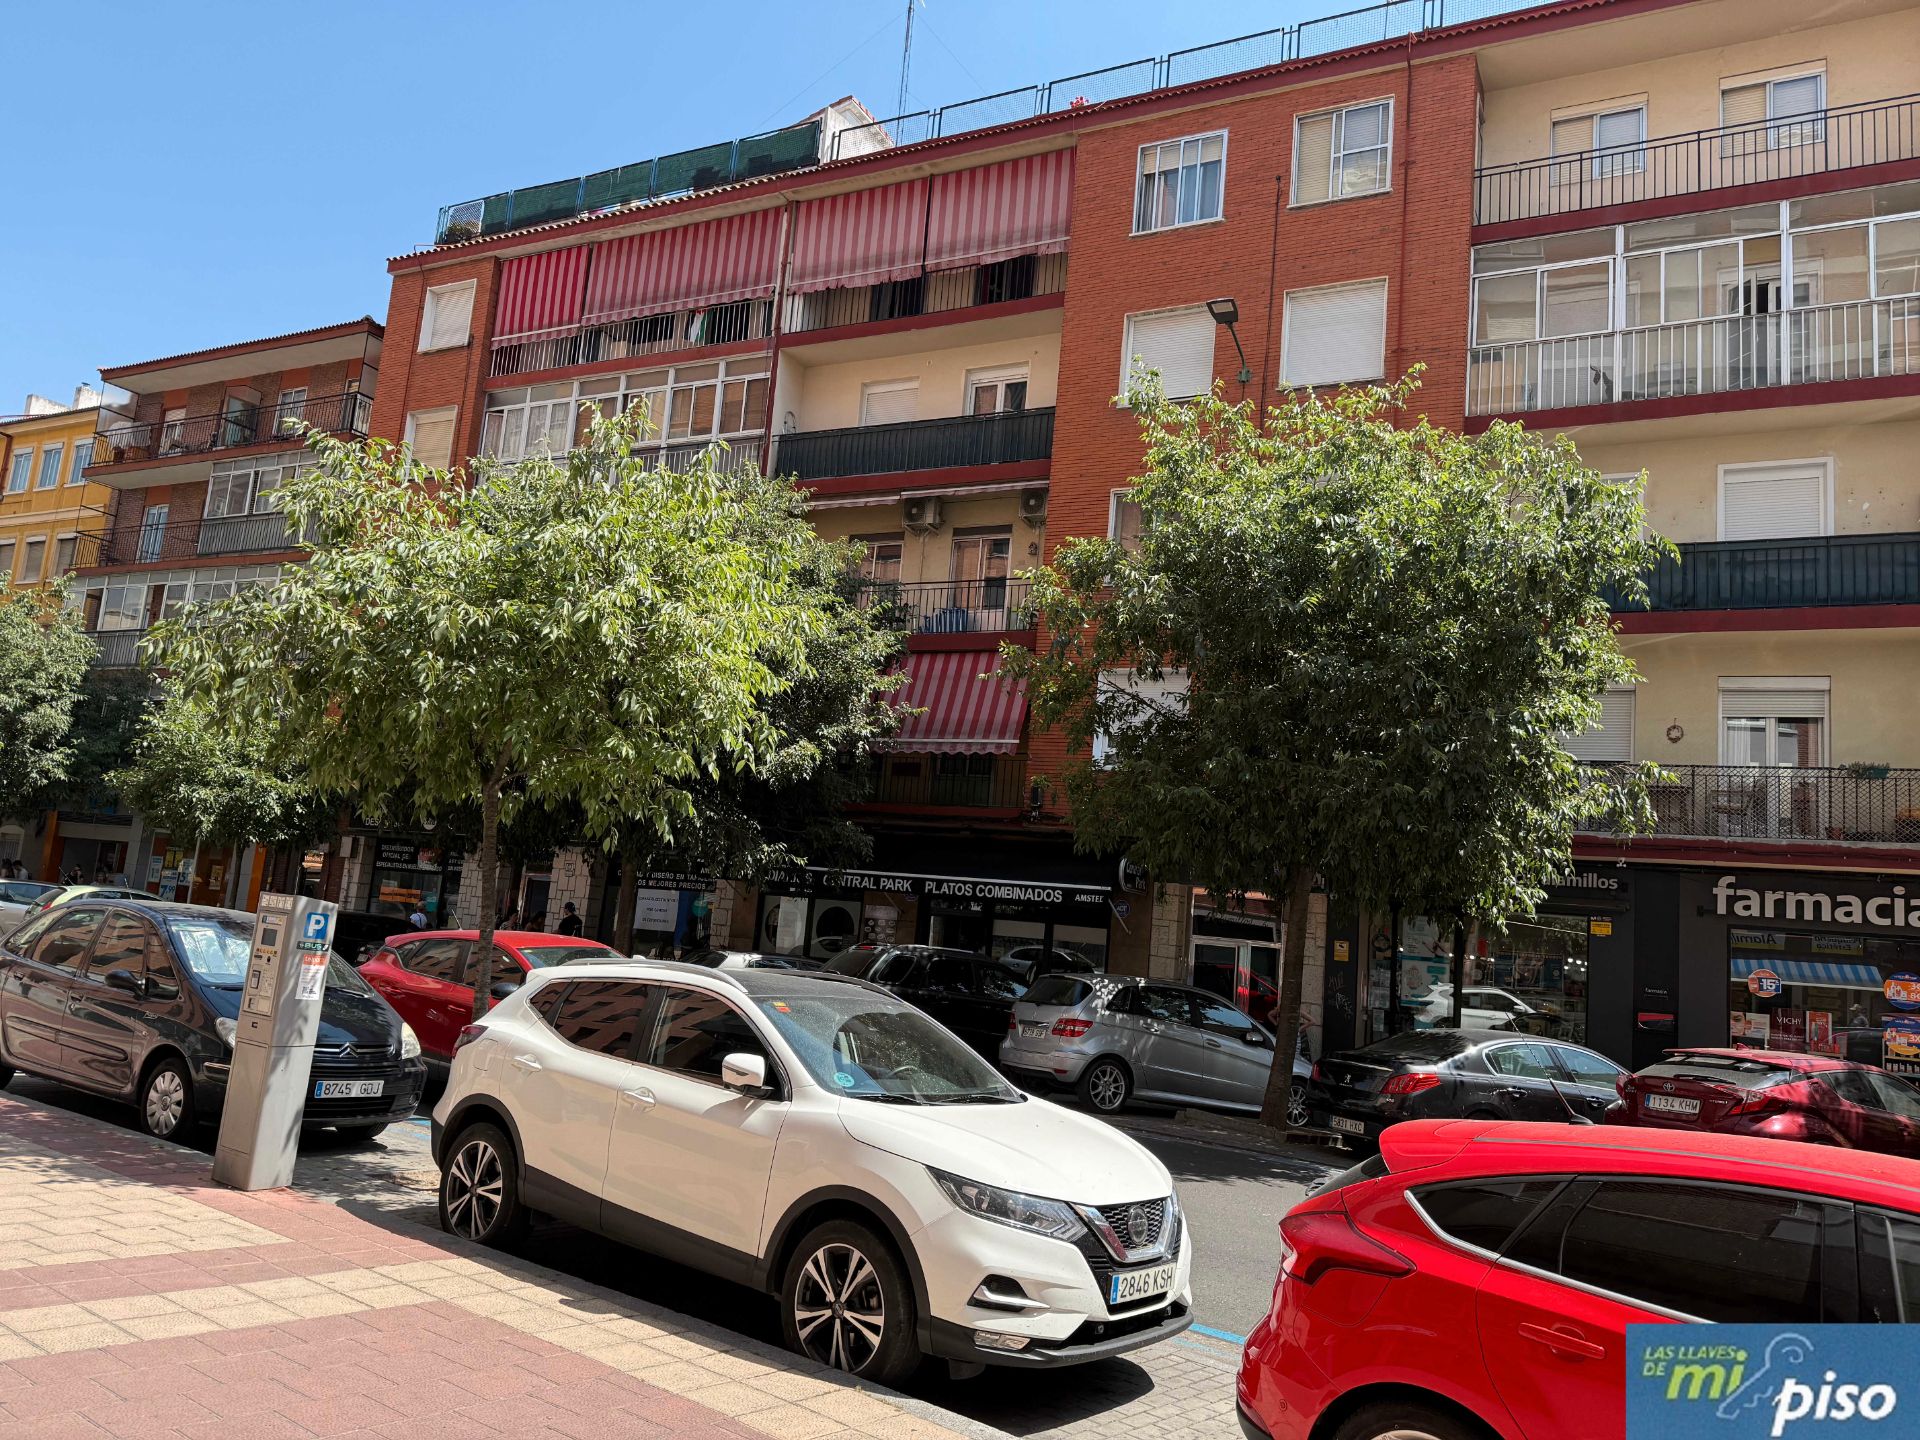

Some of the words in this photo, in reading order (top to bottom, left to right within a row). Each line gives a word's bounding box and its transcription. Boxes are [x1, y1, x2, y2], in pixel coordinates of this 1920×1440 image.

[651, 871, 674, 879] DISEÑO
[648, 880, 676, 888] MEJORES
[678, 882, 706, 890] PRECIOS
[880, 877, 913, 892] PARK
[925, 881, 973, 896] PLATOS
[975, 884, 1063, 903] COMBINADOS
[307, 914, 325, 937] P
[1776, 1016, 1802, 1025] VICHY
[323, 1082, 352, 1095] 8745
[359, 1082, 381, 1095] GDJ
[1653, 1096, 1675, 1109] 1134
[1678, 1099, 1698, 1112] KHM
[1119, 1272, 1151, 1299] 2846
[1153, 1266, 1174, 1291] KSH
